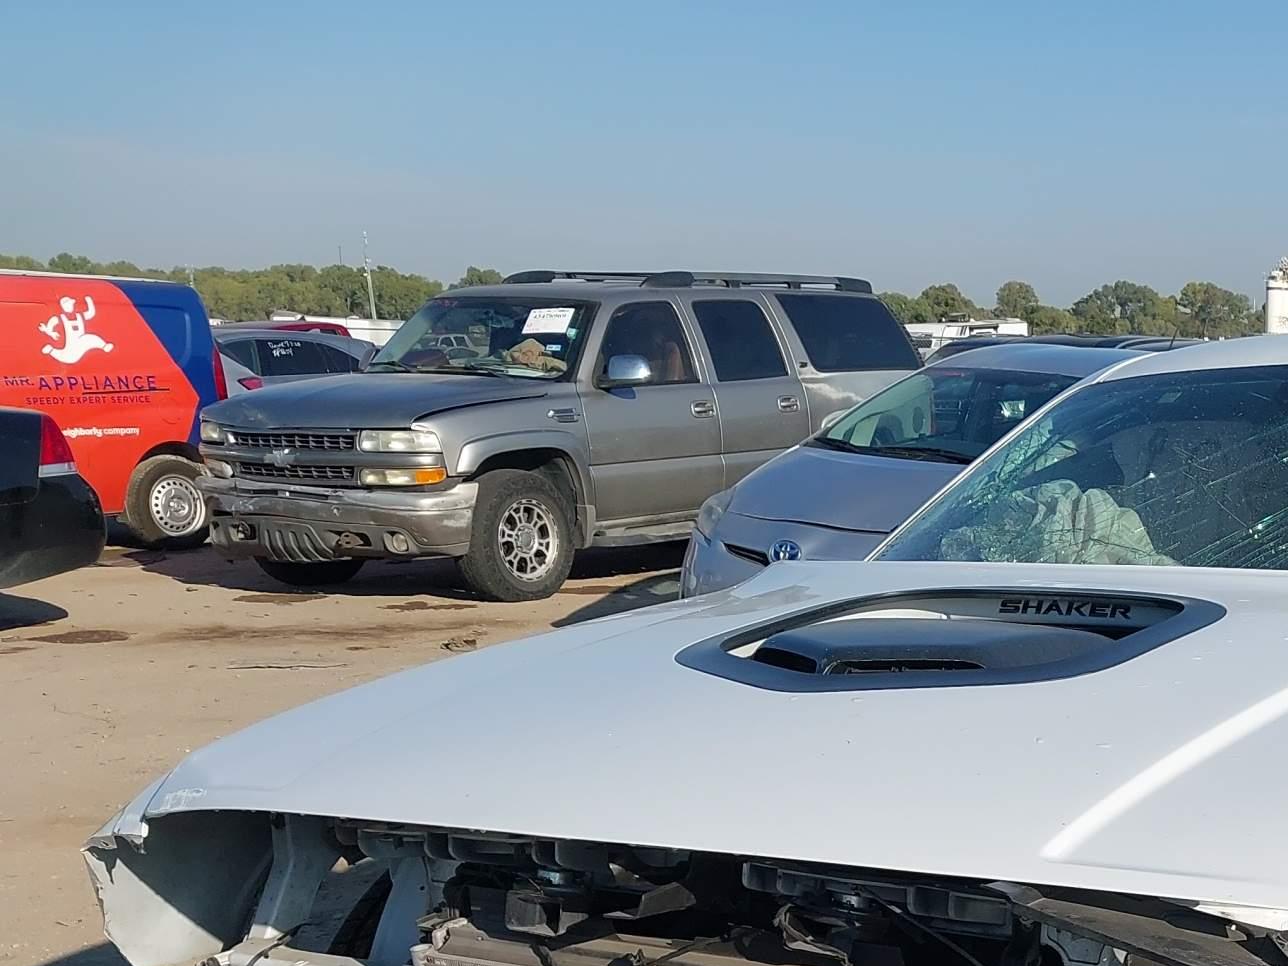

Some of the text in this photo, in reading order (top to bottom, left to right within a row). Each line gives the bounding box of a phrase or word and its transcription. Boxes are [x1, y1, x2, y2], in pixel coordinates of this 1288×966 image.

[4, 376, 157, 391] MR. APPLIANCE
[26, 395, 150, 405] SPEEDY EXPERT SERVICE
[61, 427, 139, 438] eighborly company
[999, 599, 1131, 620] SHAKER
